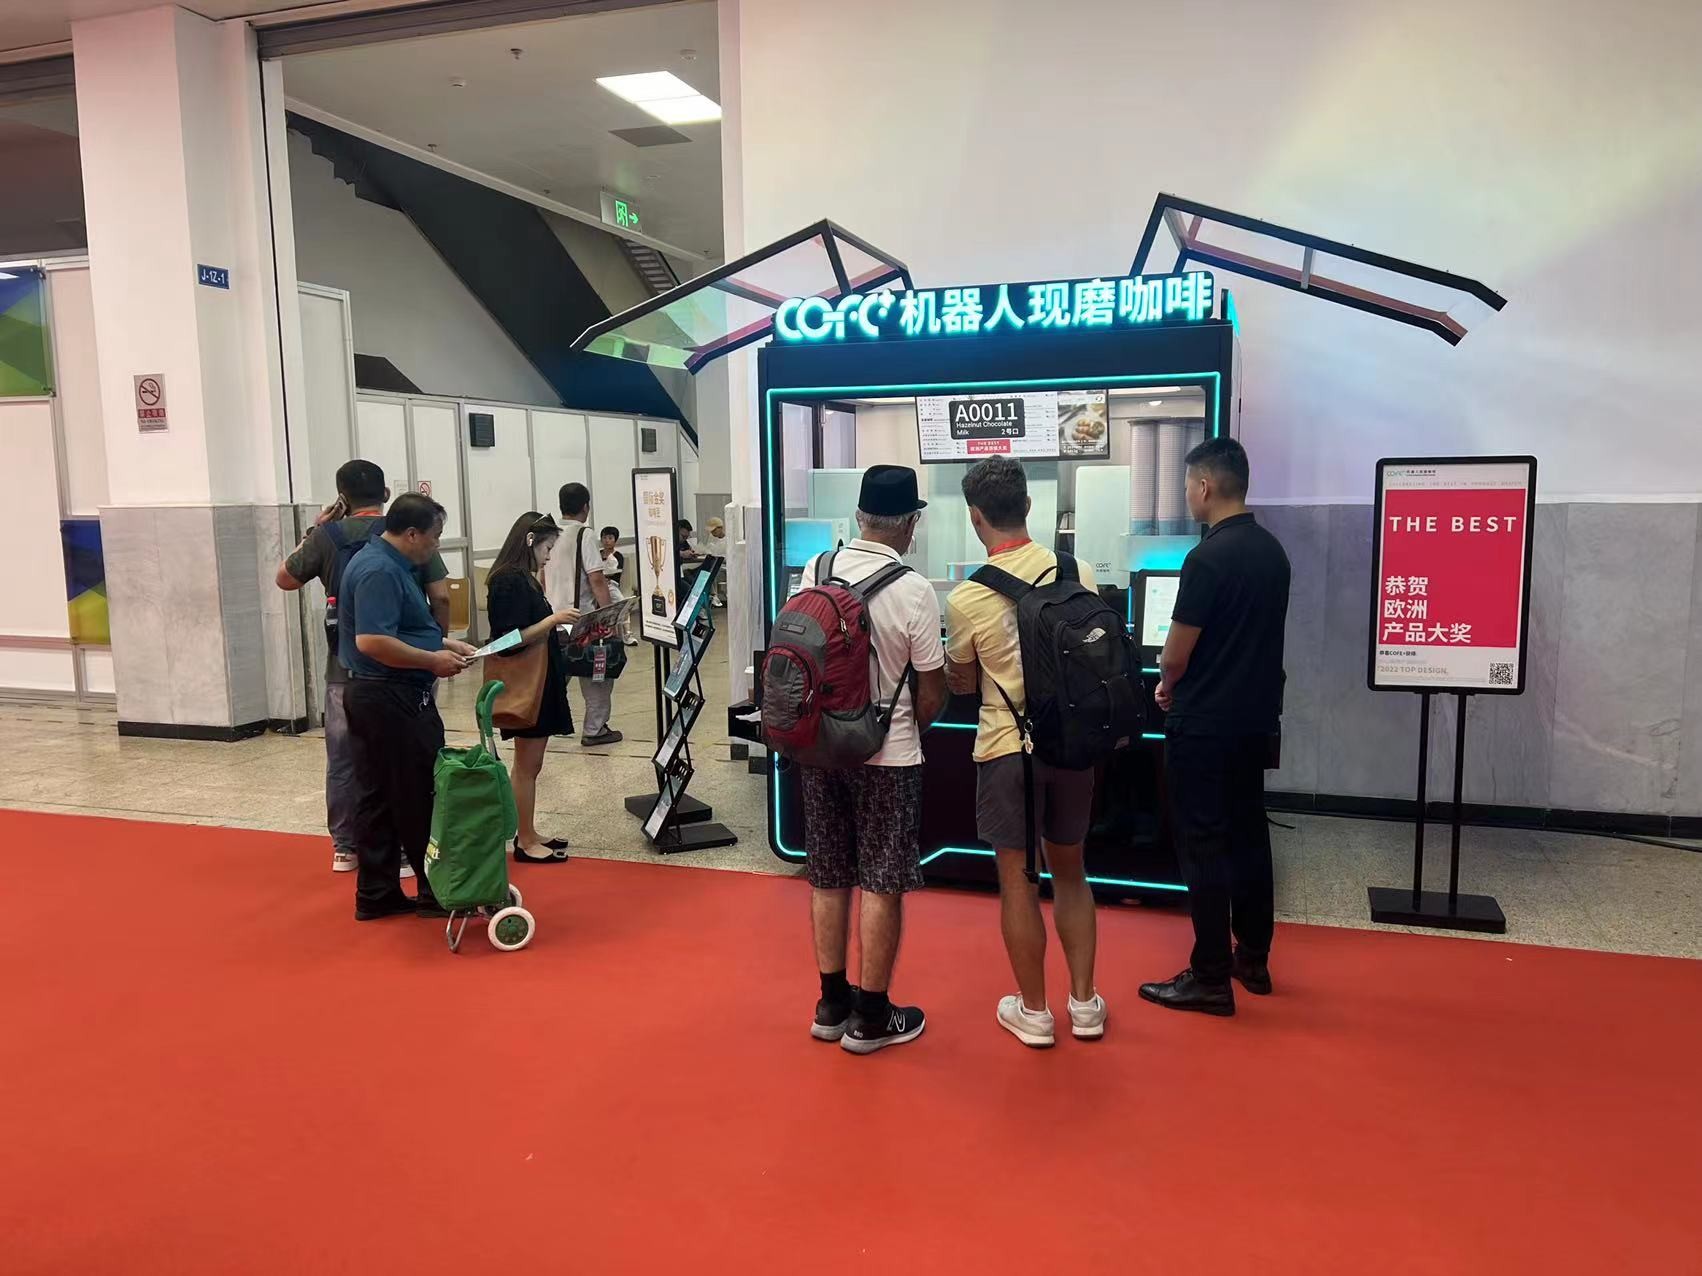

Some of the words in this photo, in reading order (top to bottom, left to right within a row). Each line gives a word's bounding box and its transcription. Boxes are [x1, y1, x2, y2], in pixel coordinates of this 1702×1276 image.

[898, 271, 1213, 336] 机器人现磨咖啡
[955, 402, 1018, 422] A0011
[956, 421, 982, 429] Hazelnut
[983, 420, 1013, 428] Chocolate
[1389, 516, 1437, 532] THE
[1451, 516, 1517, 532] BEST
[1385, 576, 1428, 596] 恭贺
[1384, 599, 1428, 620] 欧洲
[1383, 621, 1472, 643] 产品大奖
